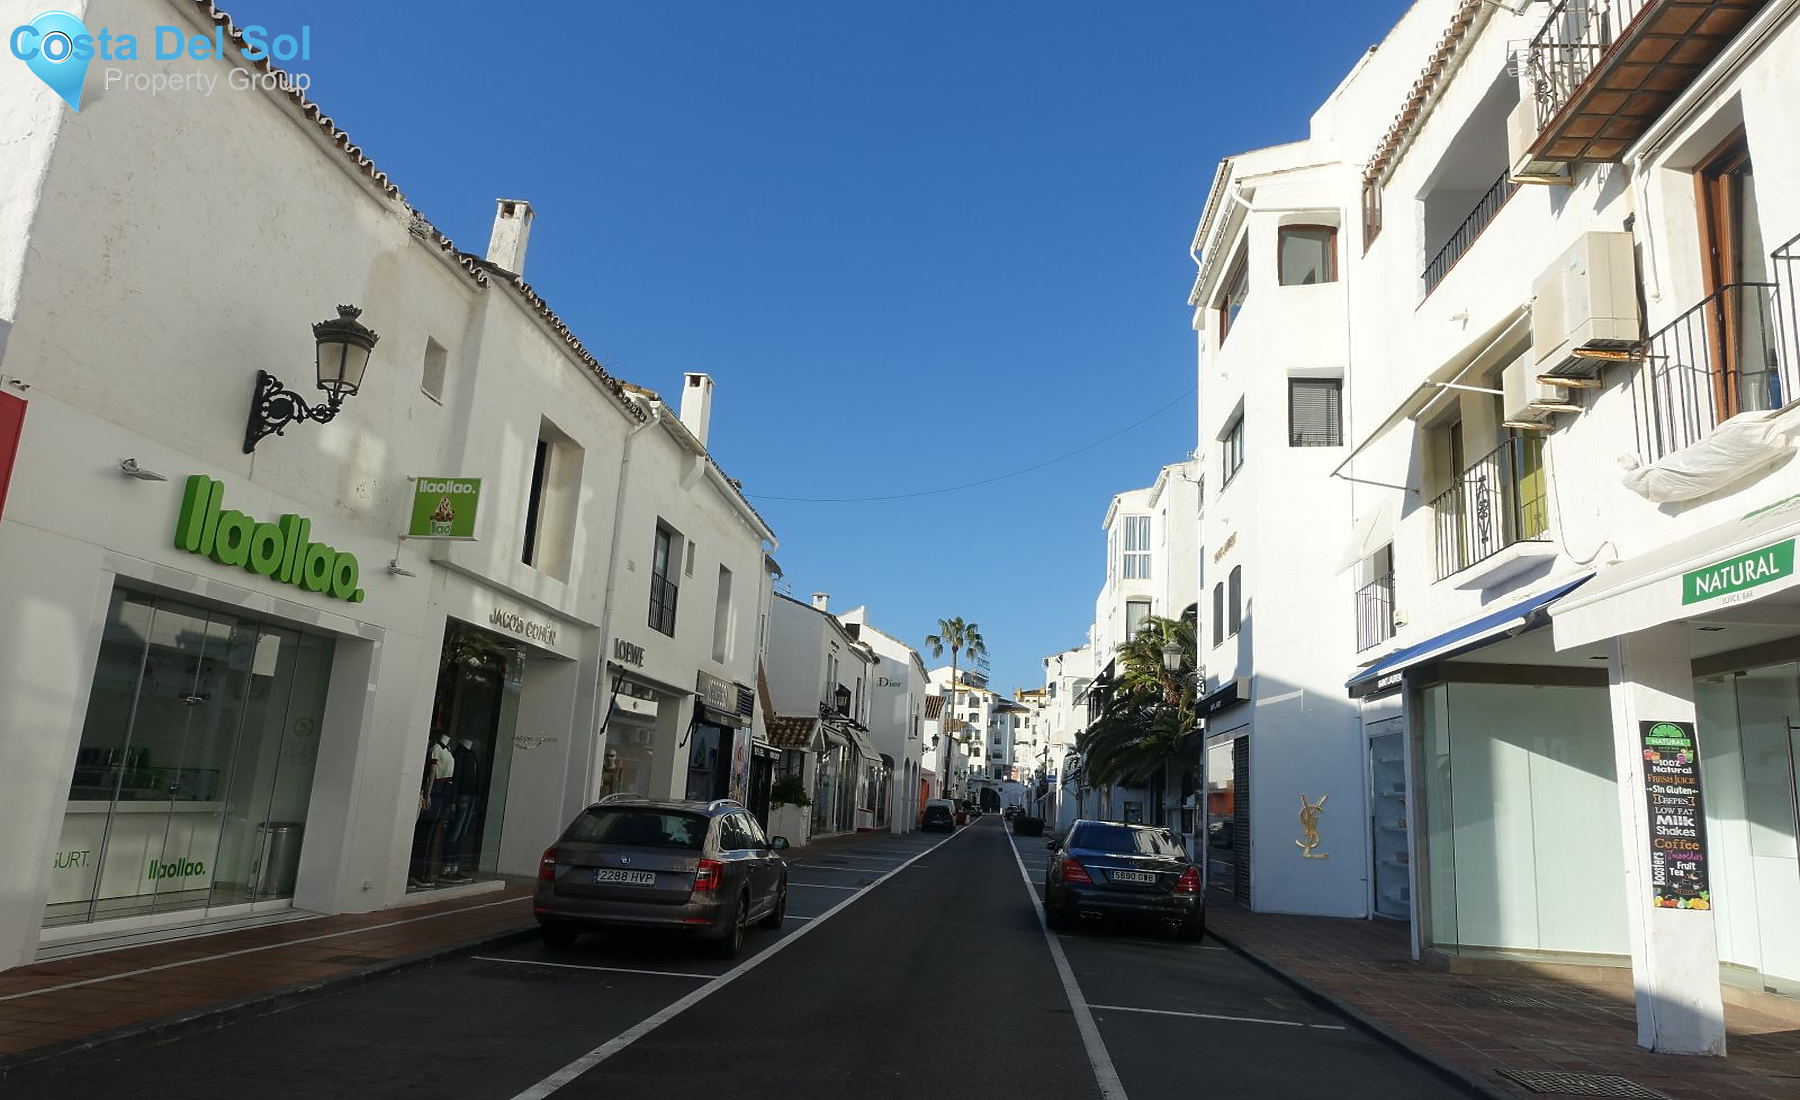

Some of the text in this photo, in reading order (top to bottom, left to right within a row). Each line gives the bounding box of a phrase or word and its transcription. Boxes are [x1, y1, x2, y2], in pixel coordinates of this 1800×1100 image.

[1696, 553, 1780, 596] NATURAL
[489, 608, 524, 633] JACOB
[613, 637, 646, 668] LOEWE
[878, 676, 901, 688] Dior
[1651, 738, 1686, 747] NATURAL
[1652, 766, 1692, 774] Natural
[1652, 785, 1693, 795] Sin Gluten
[1655, 806, 1695, 816] LOW FAT
[1656, 815, 1695, 827] Milk
[1656, 826, 1696, 837] Shakes
[1654, 837, 1700, 850] Coffee
[1676, 861, 1696, 870] Fruit
[600, 870, 654, 884] 2288 HVP
[1669, 867, 1684, 876] Tea
